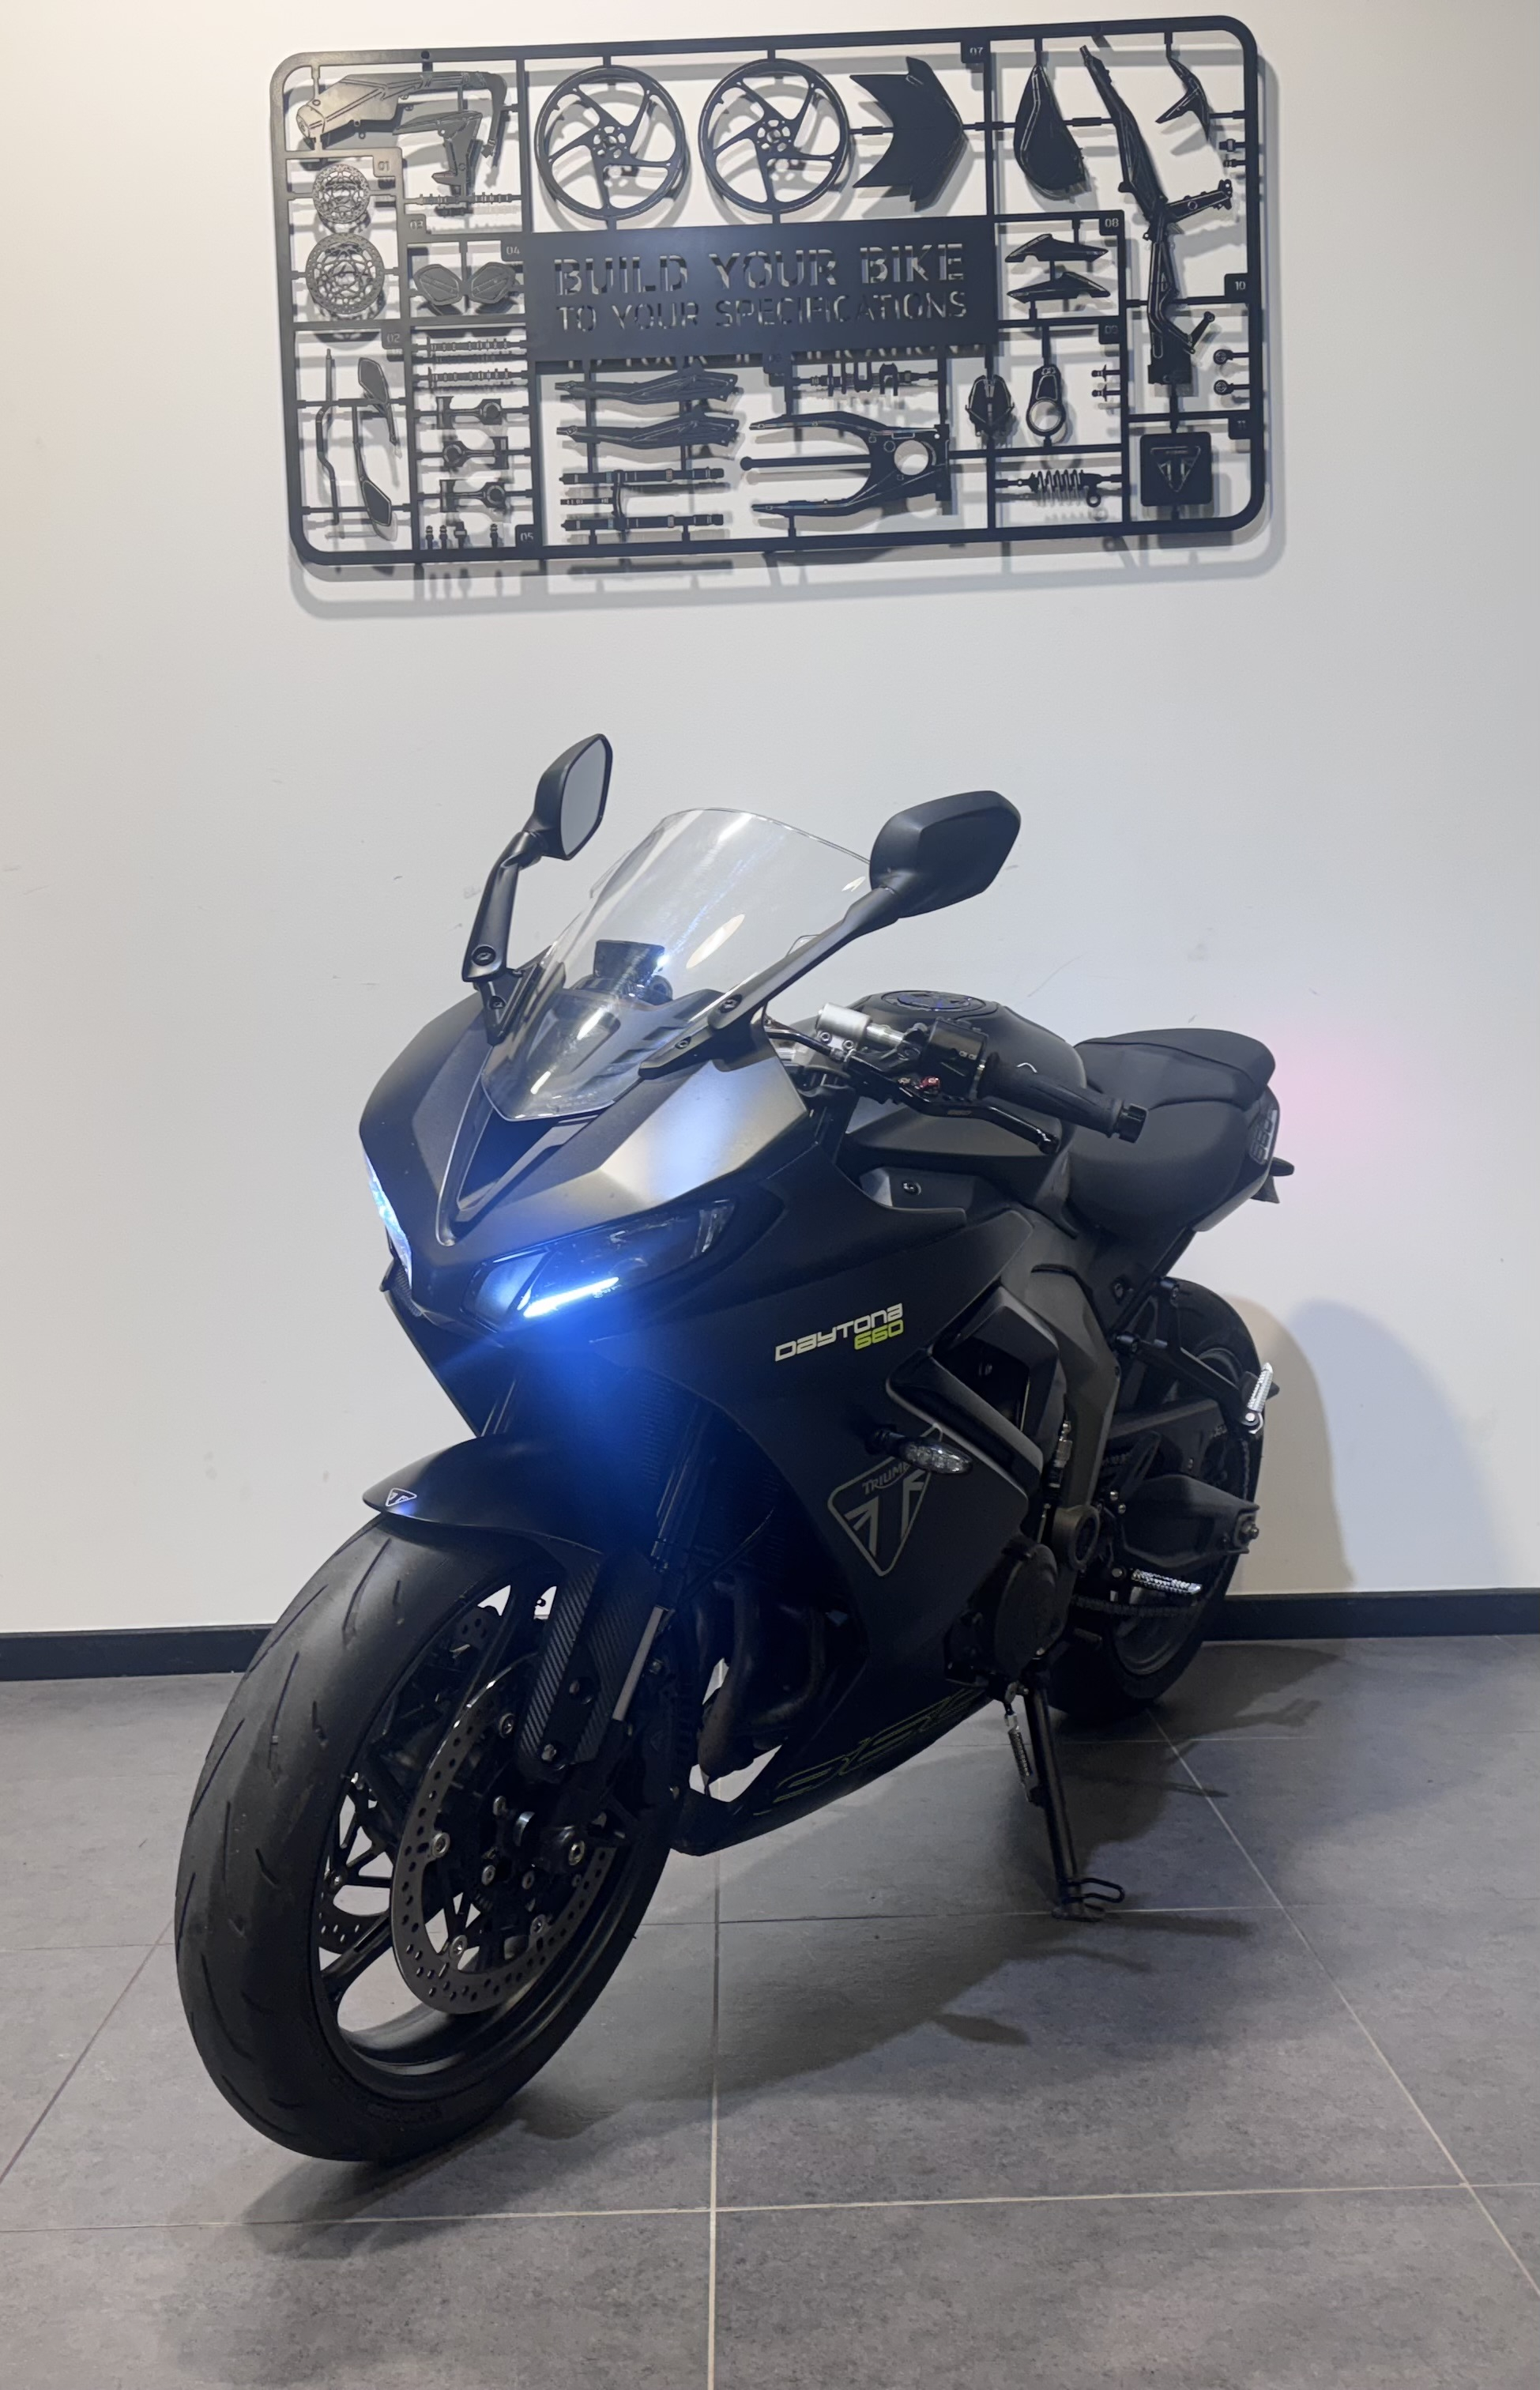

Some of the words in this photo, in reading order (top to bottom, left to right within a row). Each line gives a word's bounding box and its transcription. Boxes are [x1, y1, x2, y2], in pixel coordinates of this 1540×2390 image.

[969, 46, 984, 56] 07
[378, 160, 390, 171] 01
[1105, 217, 1120, 228] 08
[506, 246, 520, 255] 04
[554, 254, 688, 296] BUILD
[709, 249, 837, 289] YOUR
[860, 243, 964, 284] BIKE
[1234, 281, 1247, 292] 10
[556, 304, 597, 332] TO
[612, 302, 699, 330] YOUR
[715, 291, 967, 327] SPECIFICATIONS
[386, 332, 401, 343] 02
[520, 532, 534, 542] 05
[854, 1319, 904, 1350] 660
[862, 1461, 911, 1495] TRIUMP
